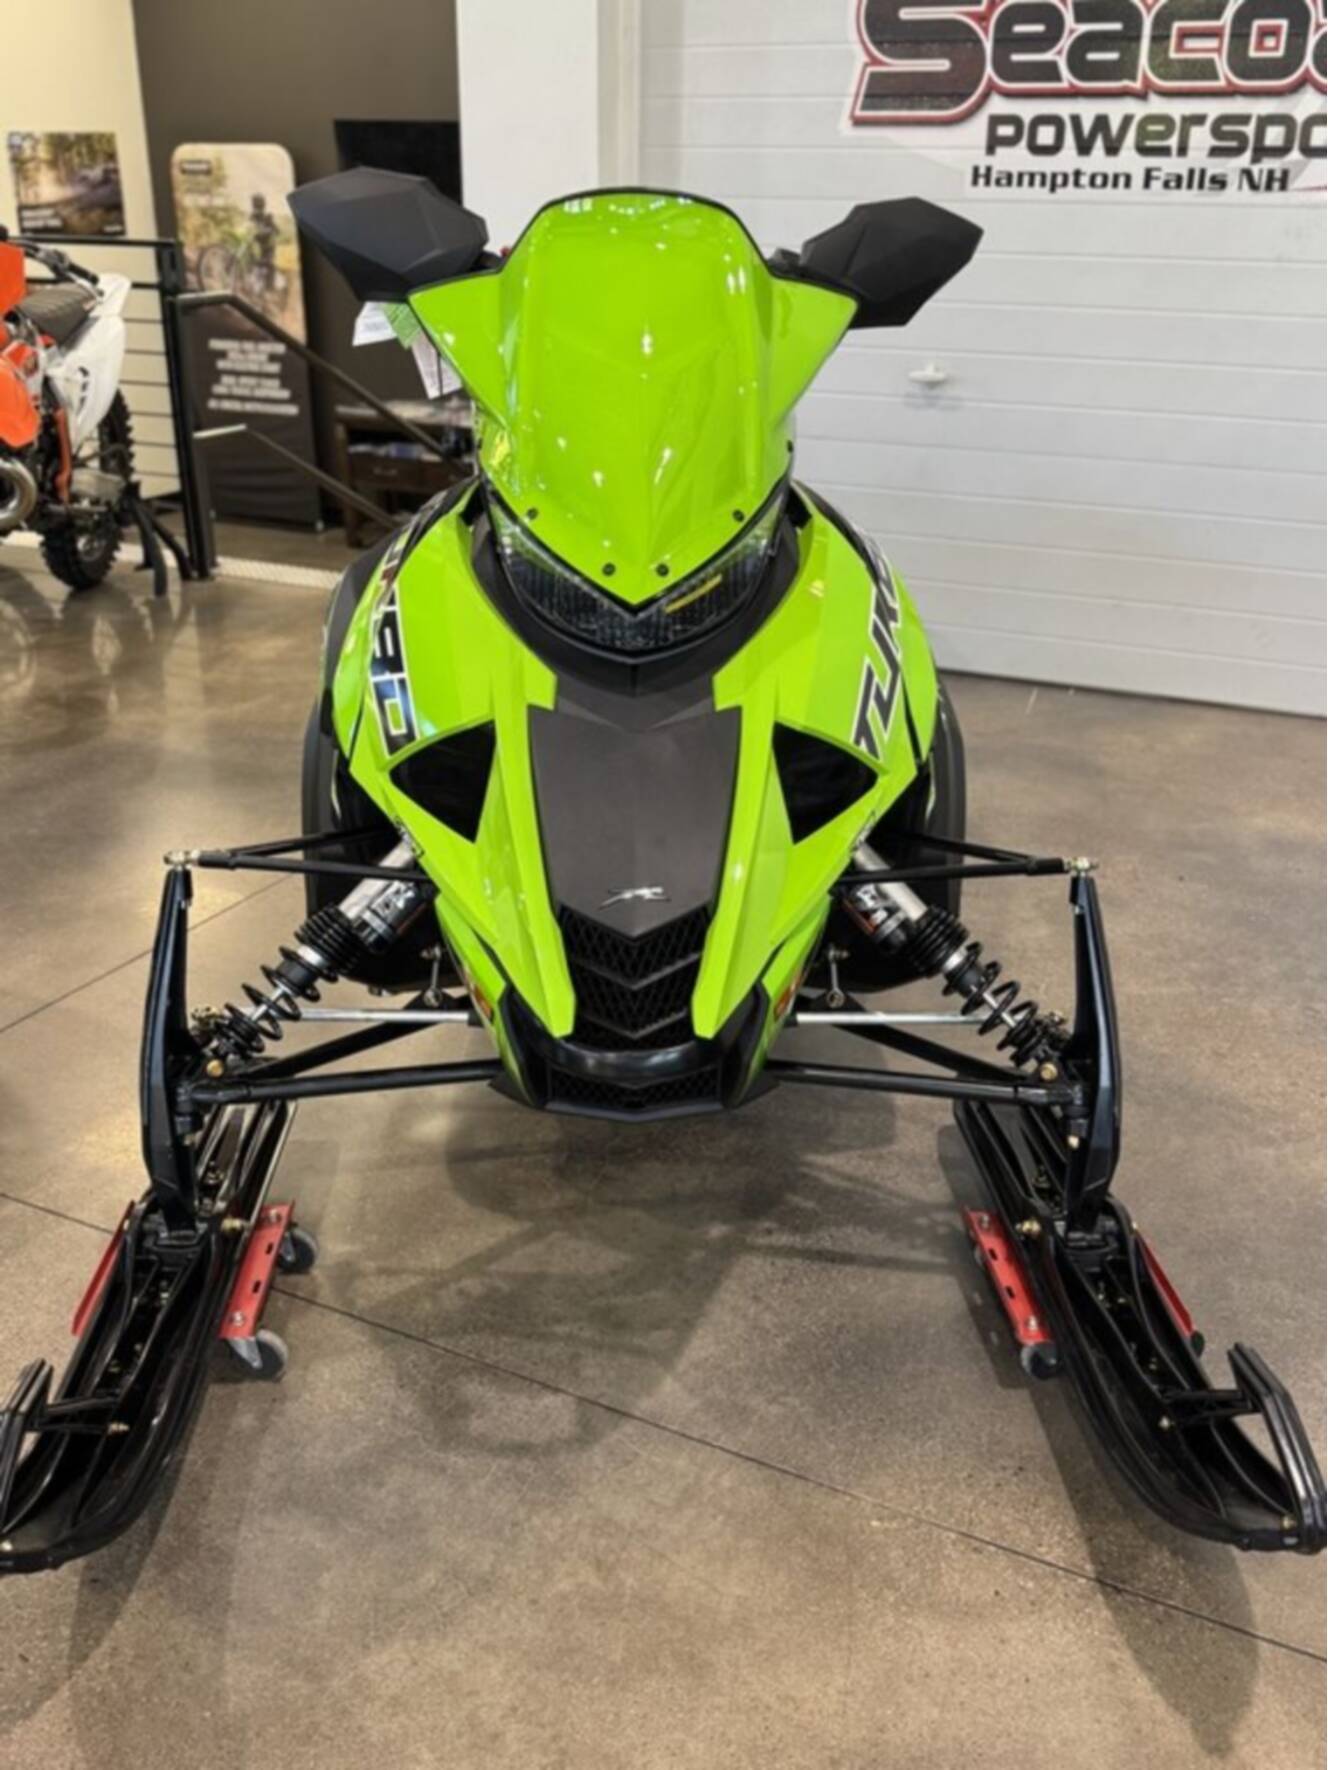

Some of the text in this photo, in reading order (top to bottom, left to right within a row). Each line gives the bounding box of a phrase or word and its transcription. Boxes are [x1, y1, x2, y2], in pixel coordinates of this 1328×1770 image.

[852, 0, 1327, 125] Seaco
[970, 165, 1290, 193] Hampton Falls NH
